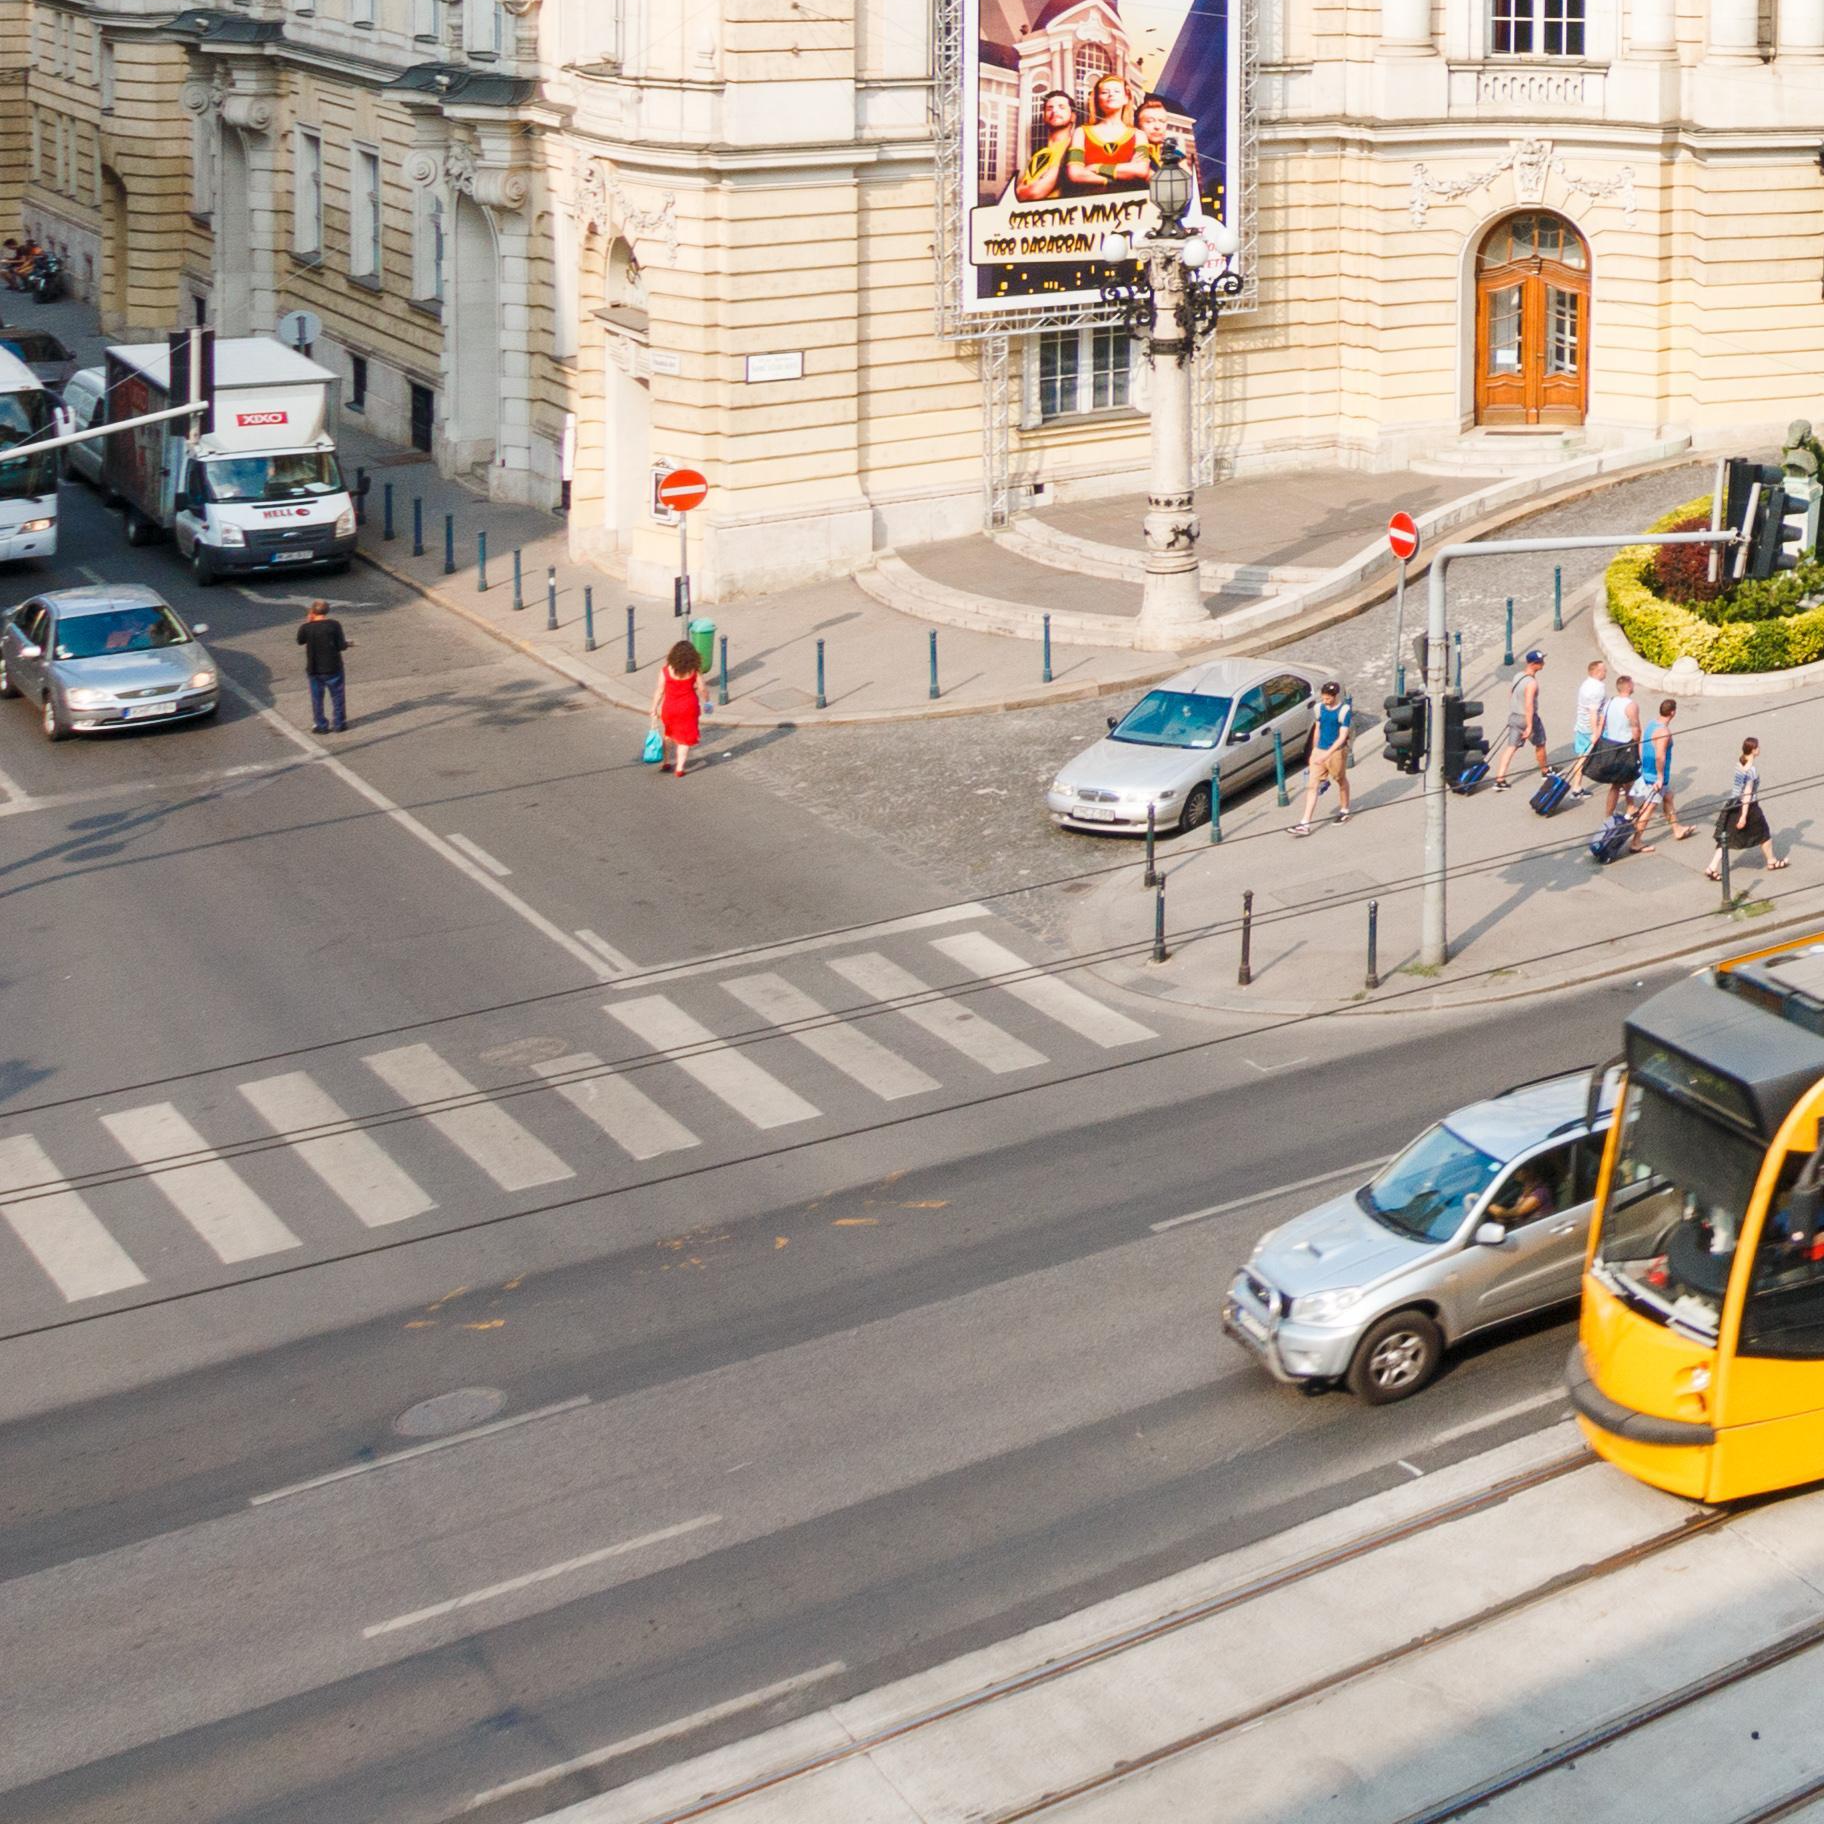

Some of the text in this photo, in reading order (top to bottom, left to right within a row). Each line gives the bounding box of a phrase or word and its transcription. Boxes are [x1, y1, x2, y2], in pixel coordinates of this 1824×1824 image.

[1008, 198, 1149, 231] SZERETNE MINKET
[984, 233, 1016, 257] TÖBB
[1020, 232, 1096, 256] DARABBAN
[243, 413, 283, 425] XIXO
[262, 507, 294, 519] HELL
